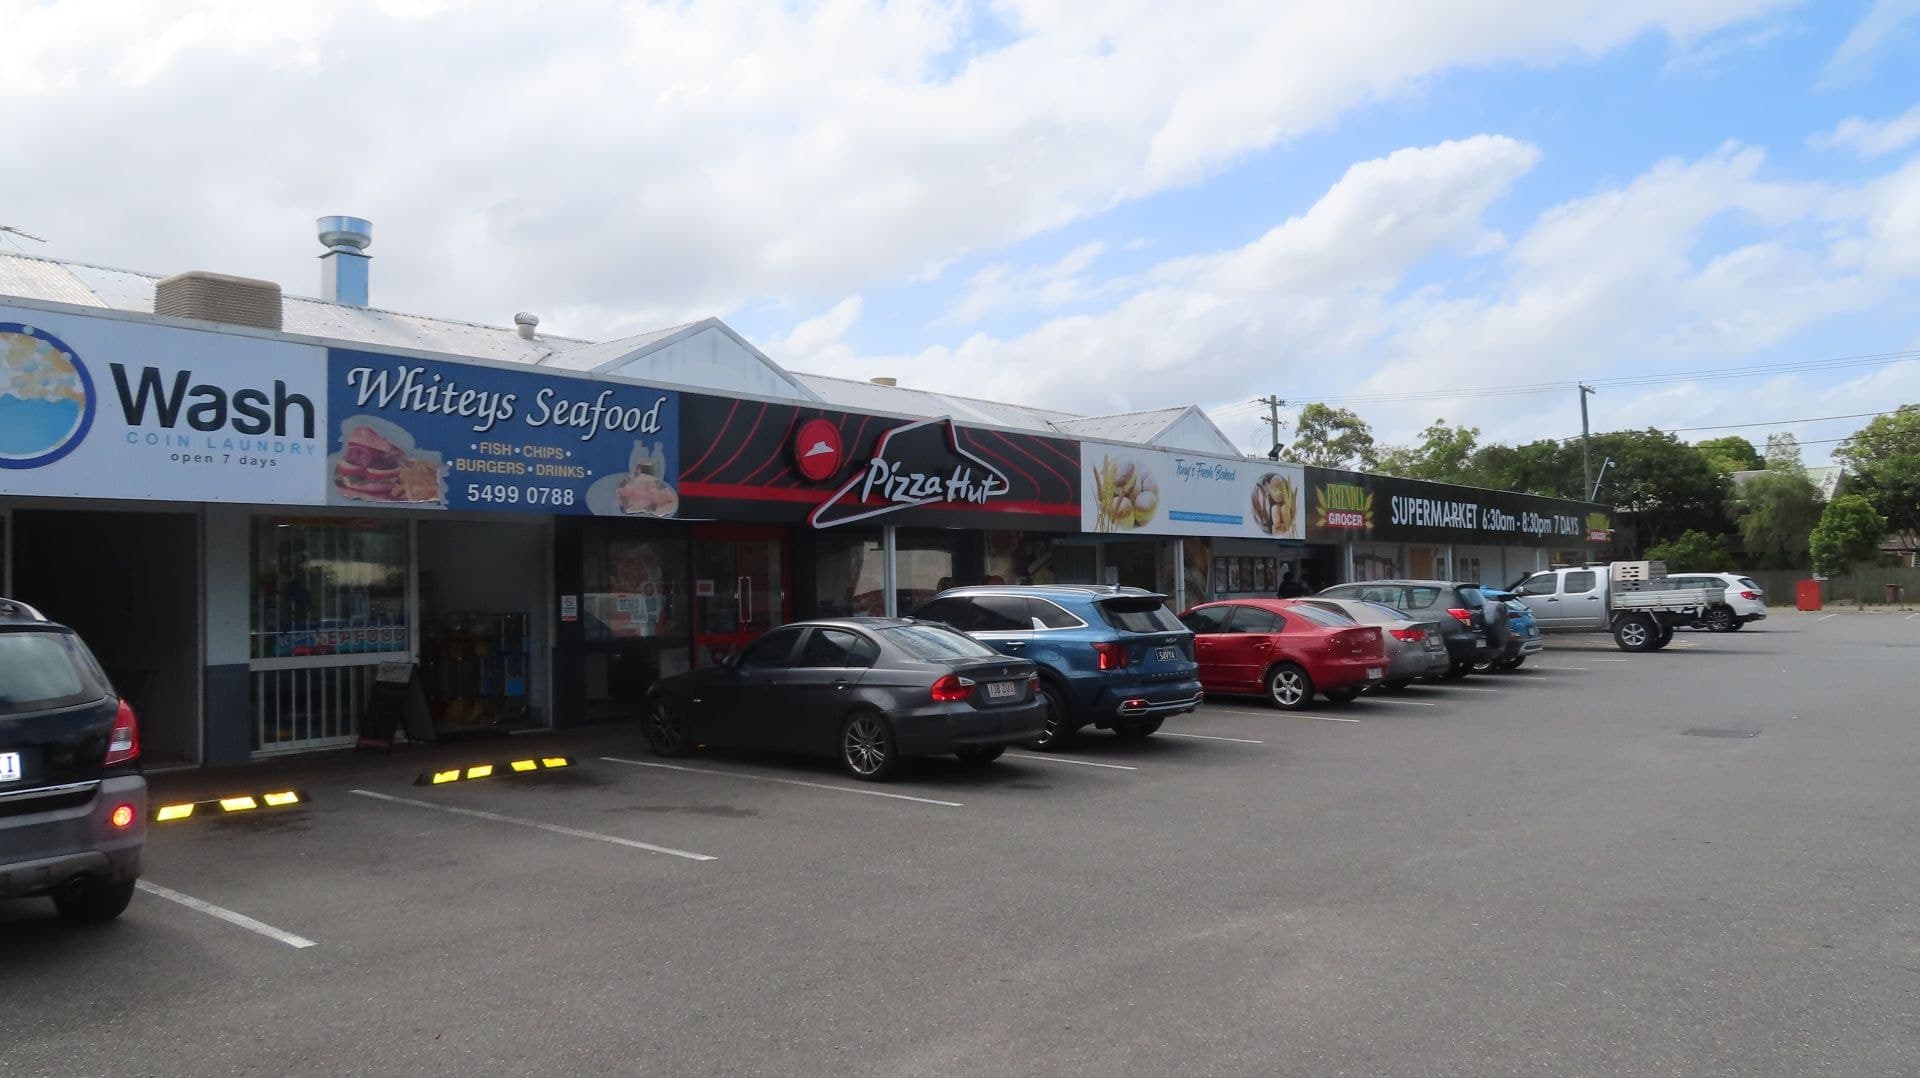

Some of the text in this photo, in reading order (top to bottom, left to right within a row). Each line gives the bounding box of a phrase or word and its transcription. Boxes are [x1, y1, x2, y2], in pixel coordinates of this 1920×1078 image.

[109, 362, 315, 438] Wash
[347, 365, 667, 441] Whiteys Seafood
[126, 431, 316, 455] COIN LAUNDRY
[479, 441, 564, 460] FISH CHIPS
[171, 453, 278, 469] open 7 days
[456, 458, 585, 478] BURGERS DRINKS
[861, 457, 1000, 505] Pizza Hut
[467, 483, 575, 506] 5499 0788
[1327, 483, 1367, 511] FRIENDLY
[1328, 512, 1363, 527] GROCER
[1391, 495, 1478, 529] SUPERMARKET
[1482, 508, 1515, 531] 6:30am
[1522, 511, 1552, 538] 8:30pm
[1553, 515, 1559, 534] 7
[1560, 515, 1580, 536] DAYS
